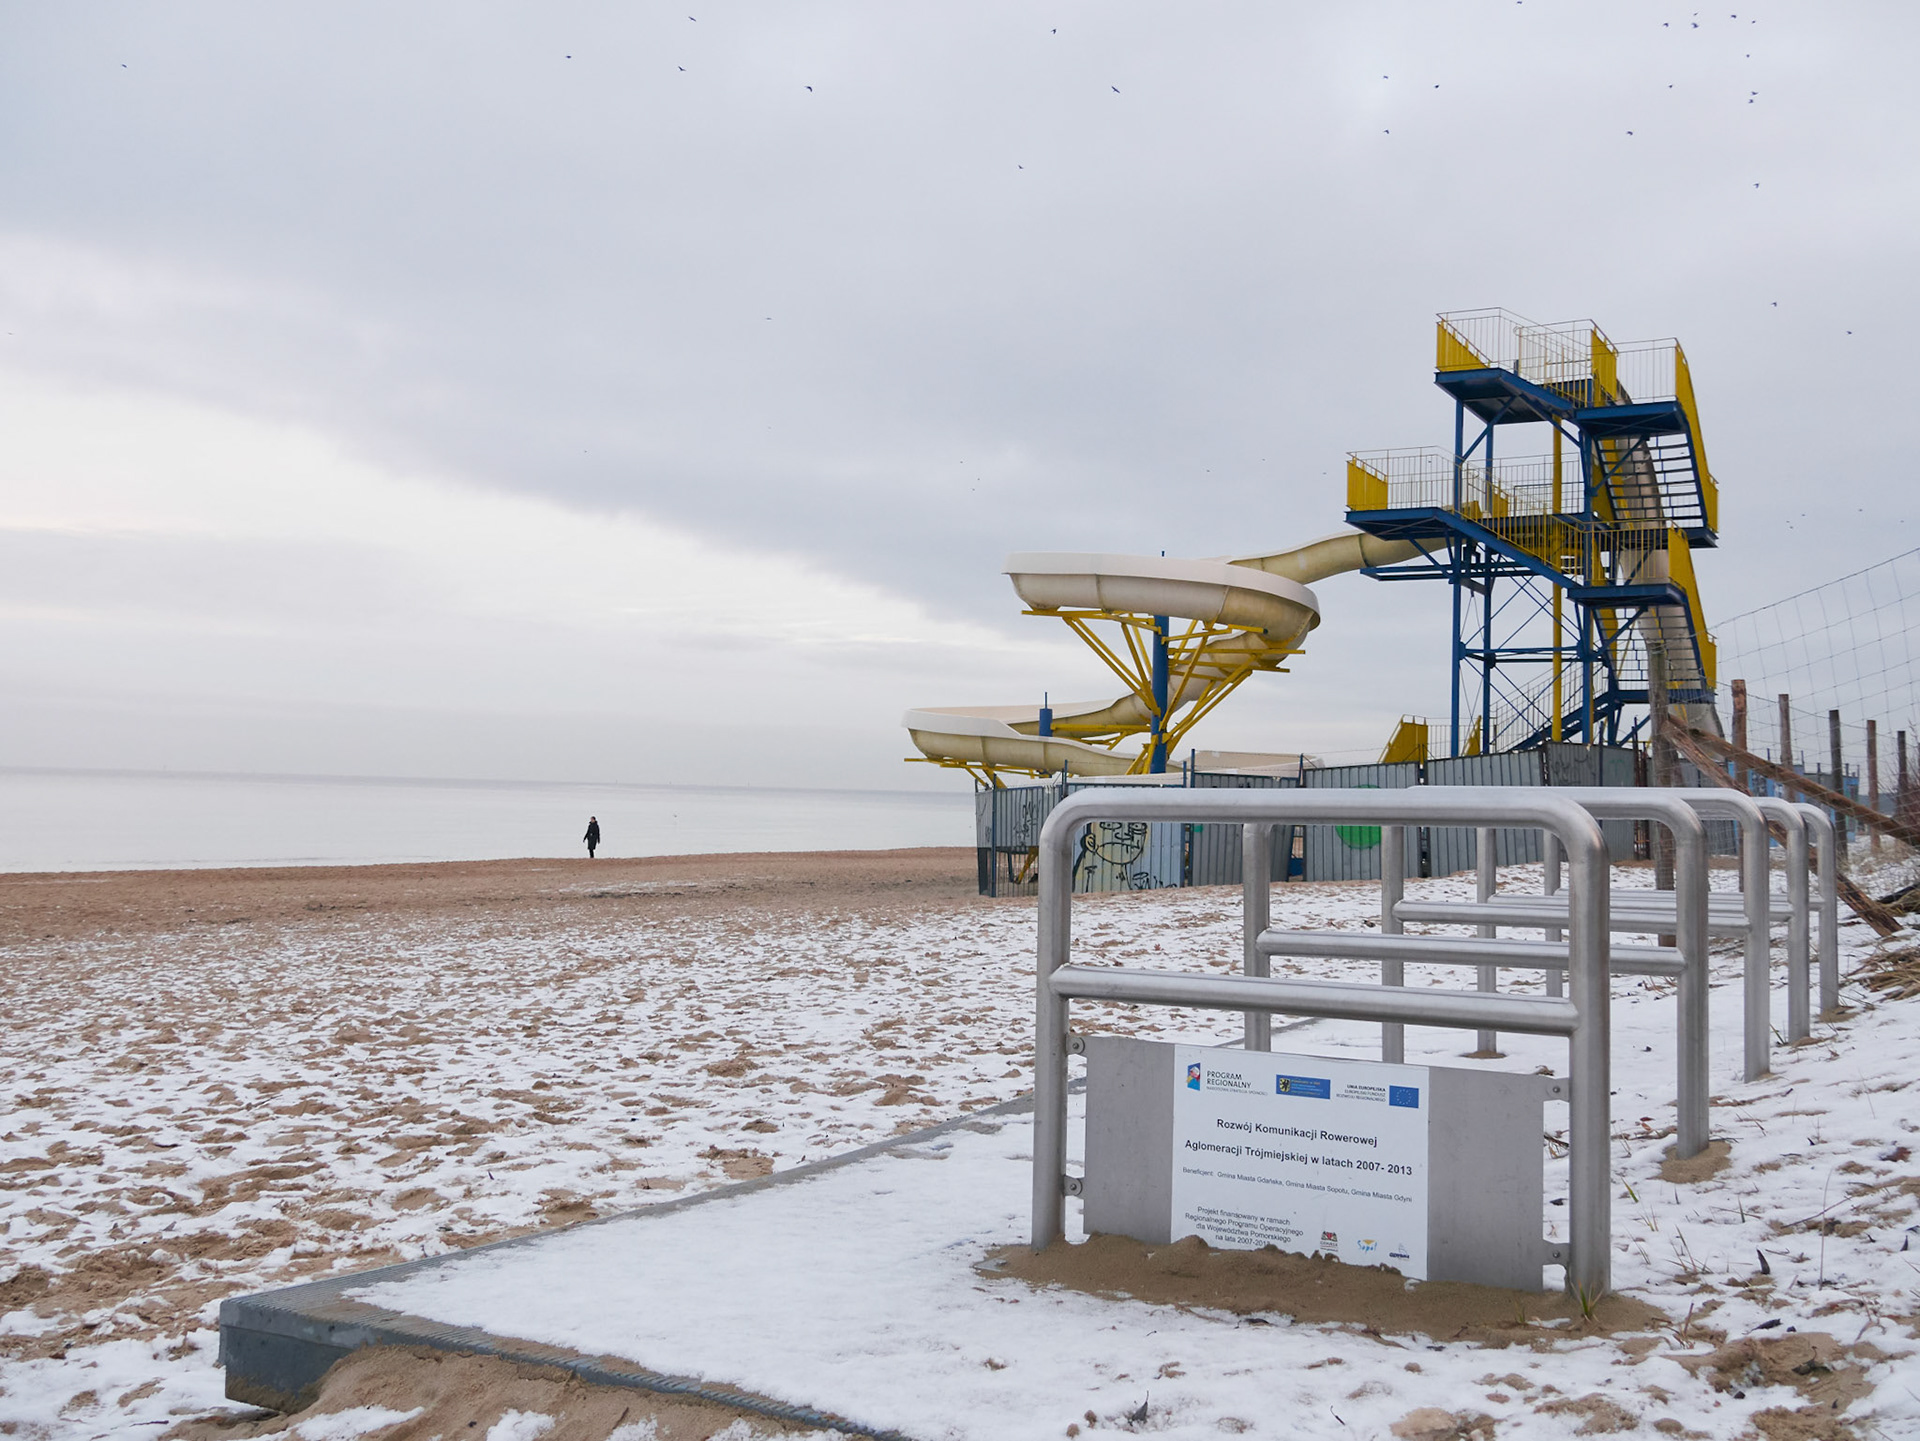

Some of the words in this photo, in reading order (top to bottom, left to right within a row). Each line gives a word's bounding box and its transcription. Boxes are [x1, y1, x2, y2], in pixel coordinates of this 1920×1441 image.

[1207, 1071, 1242, 1080] PROGRAM
[1207, 1079, 1251, 1088] REGIONALNY
[1217, 1119, 1252, 1133] Rozwój
[1255, 1123, 1317, 1140] Komunikacji
[1320, 1131, 1377, 1148] Rowerowej
[1185, 1140, 1242, 1156] Aglomeracji
[1245, 1146, 1307, 1164] Trójmiejskiej
[1322, 1156, 1353, 1168] latach
[1356, 1160, 1384, 1171] 2007-
[1387, 1164, 1412, 1175] 2013
[1237, 1174, 1255, 1182] Miasta
[1286, 1180, 1304, 1188] Gmina
[1306, 1183, 1325, 1191] Miasta
[1351, 1189, 1371, 1197] Gmina
[1372, 1192, 1392, 1200] Miasta
[1394, 1194, 1412, 1203] Gdyni
[1185, 1212, 1226, 1225] Regionalnego
[1228, 1219, 1258, 1230] Programu
[1260, 1223, 1303, 1236] Operacyjnego
[1198, 1206, 1218, 1215] Projekt
[1220, 1209, 1258, 1222] finansowany
[1266, 1217, 1290, 1225] ramach
[1207, 1224, 1248, 1236] Województwa
[1250, 1230, 1291, 1243] Pomorskiego
